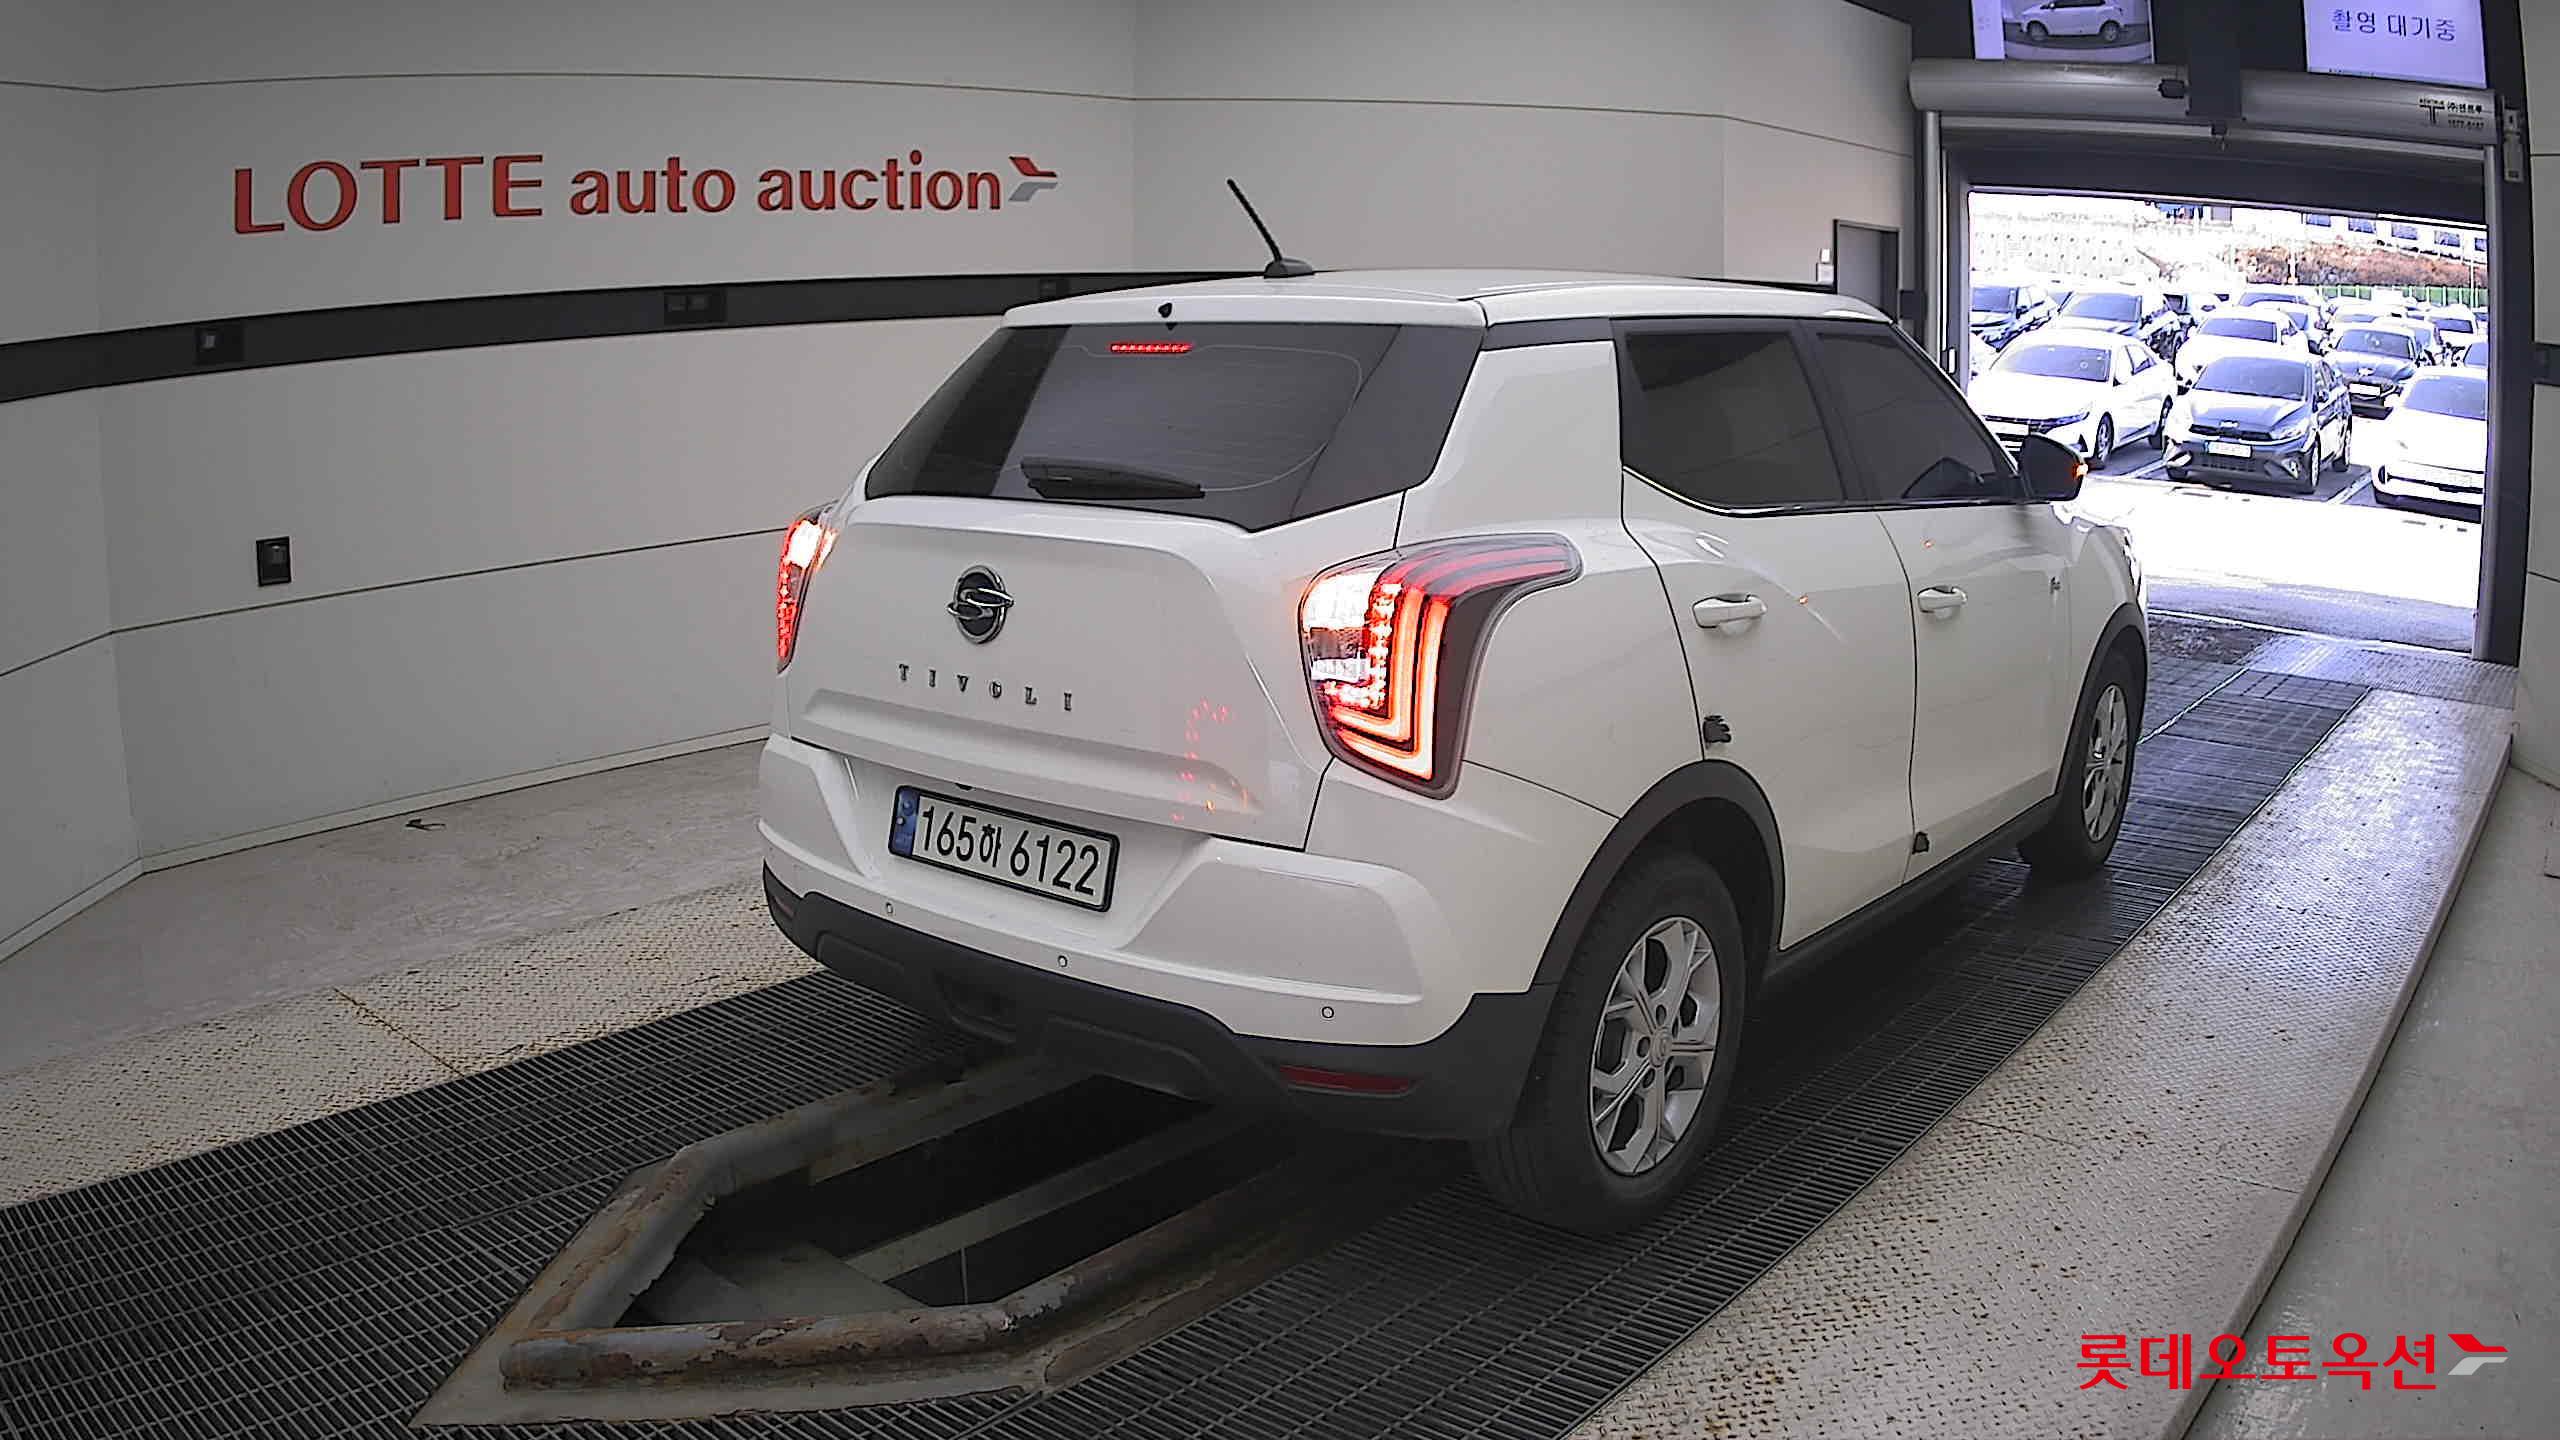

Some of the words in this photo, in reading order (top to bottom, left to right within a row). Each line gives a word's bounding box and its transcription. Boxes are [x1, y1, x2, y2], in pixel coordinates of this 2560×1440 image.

[2332, 9, 2376, 34] 촬영
[2387, 13, 2456, 42] 대기중
[234, 155, 543, 234] LOTTE
[571, 157, 736, 214] auto
[758, 151, 1002, 211] auction
[898, 663, 1073, 712] TIVOLI
[922, 805, 1002, 868] 165하
[1009, 829, 1099, 896] 6122
